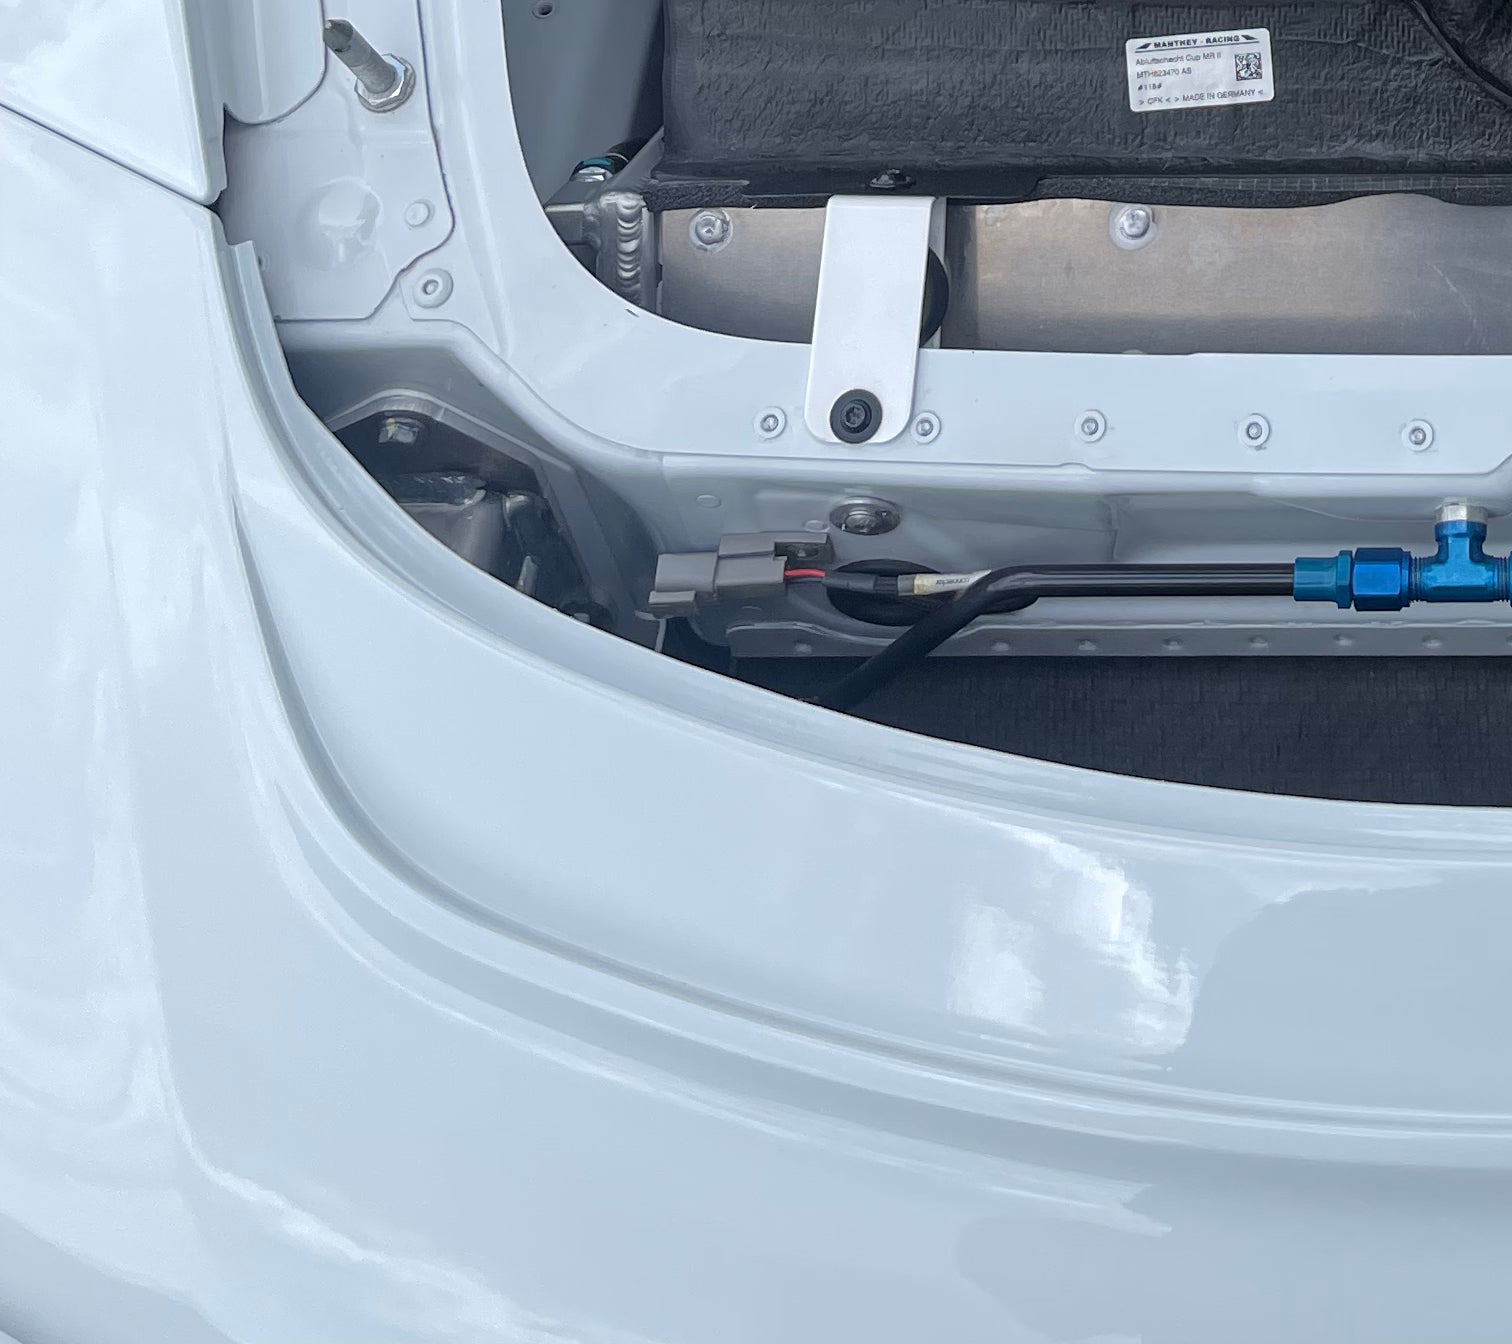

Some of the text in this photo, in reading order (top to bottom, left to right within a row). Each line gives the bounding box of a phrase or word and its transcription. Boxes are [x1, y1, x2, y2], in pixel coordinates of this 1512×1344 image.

[1205, 35, 1240, 44] RACING
[1182, 92, 1205, 102] MADE
[1206, 92, 1216, 101] IN
[1216, 88, 1256, 99] GERMANY
